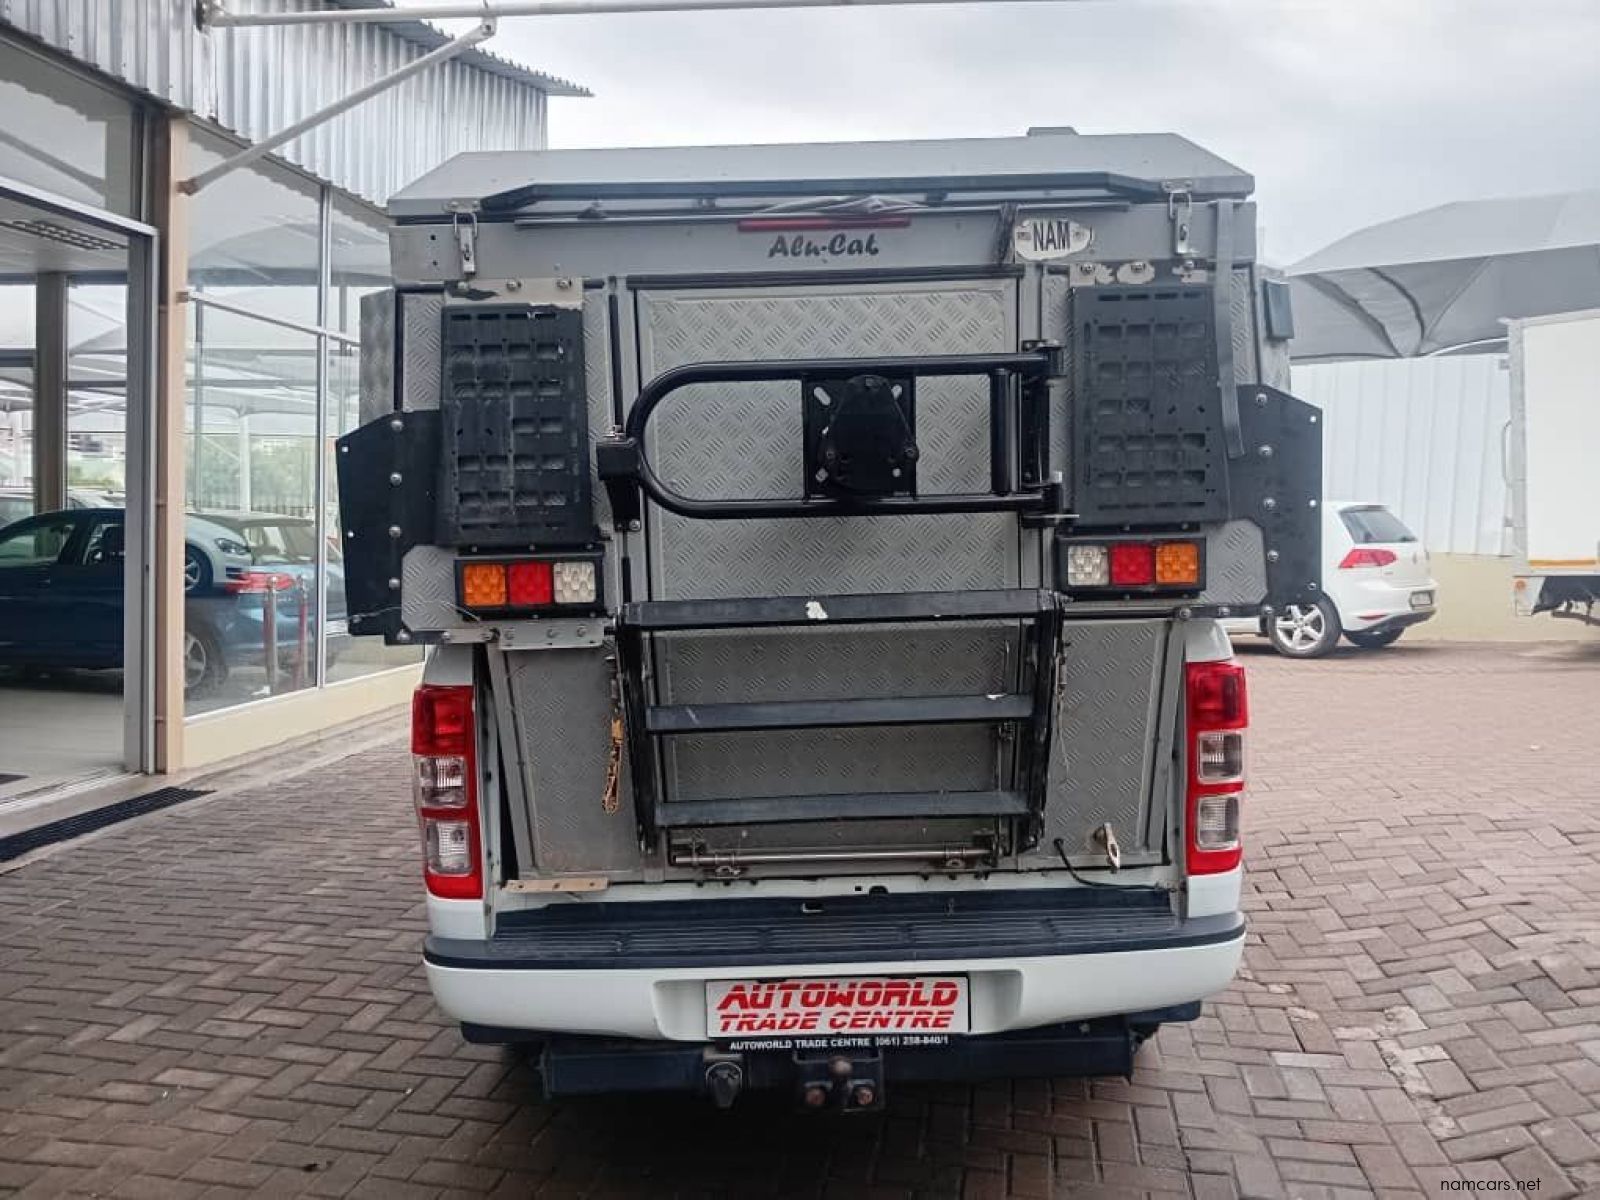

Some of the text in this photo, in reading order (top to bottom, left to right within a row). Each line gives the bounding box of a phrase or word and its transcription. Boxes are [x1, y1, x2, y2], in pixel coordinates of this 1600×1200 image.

[1033, 221, 1070, 251] NAM
[717, 981, 959, 1011] AUTOWORLD
[720, 1010, 954, 1032] TRADE CENTRE
[730, 1040, 792, 1050] AUTOWORLD
[795, 1039, 828, 1049] TRADE
[830, 1037, 870, 1048] CENTRE
